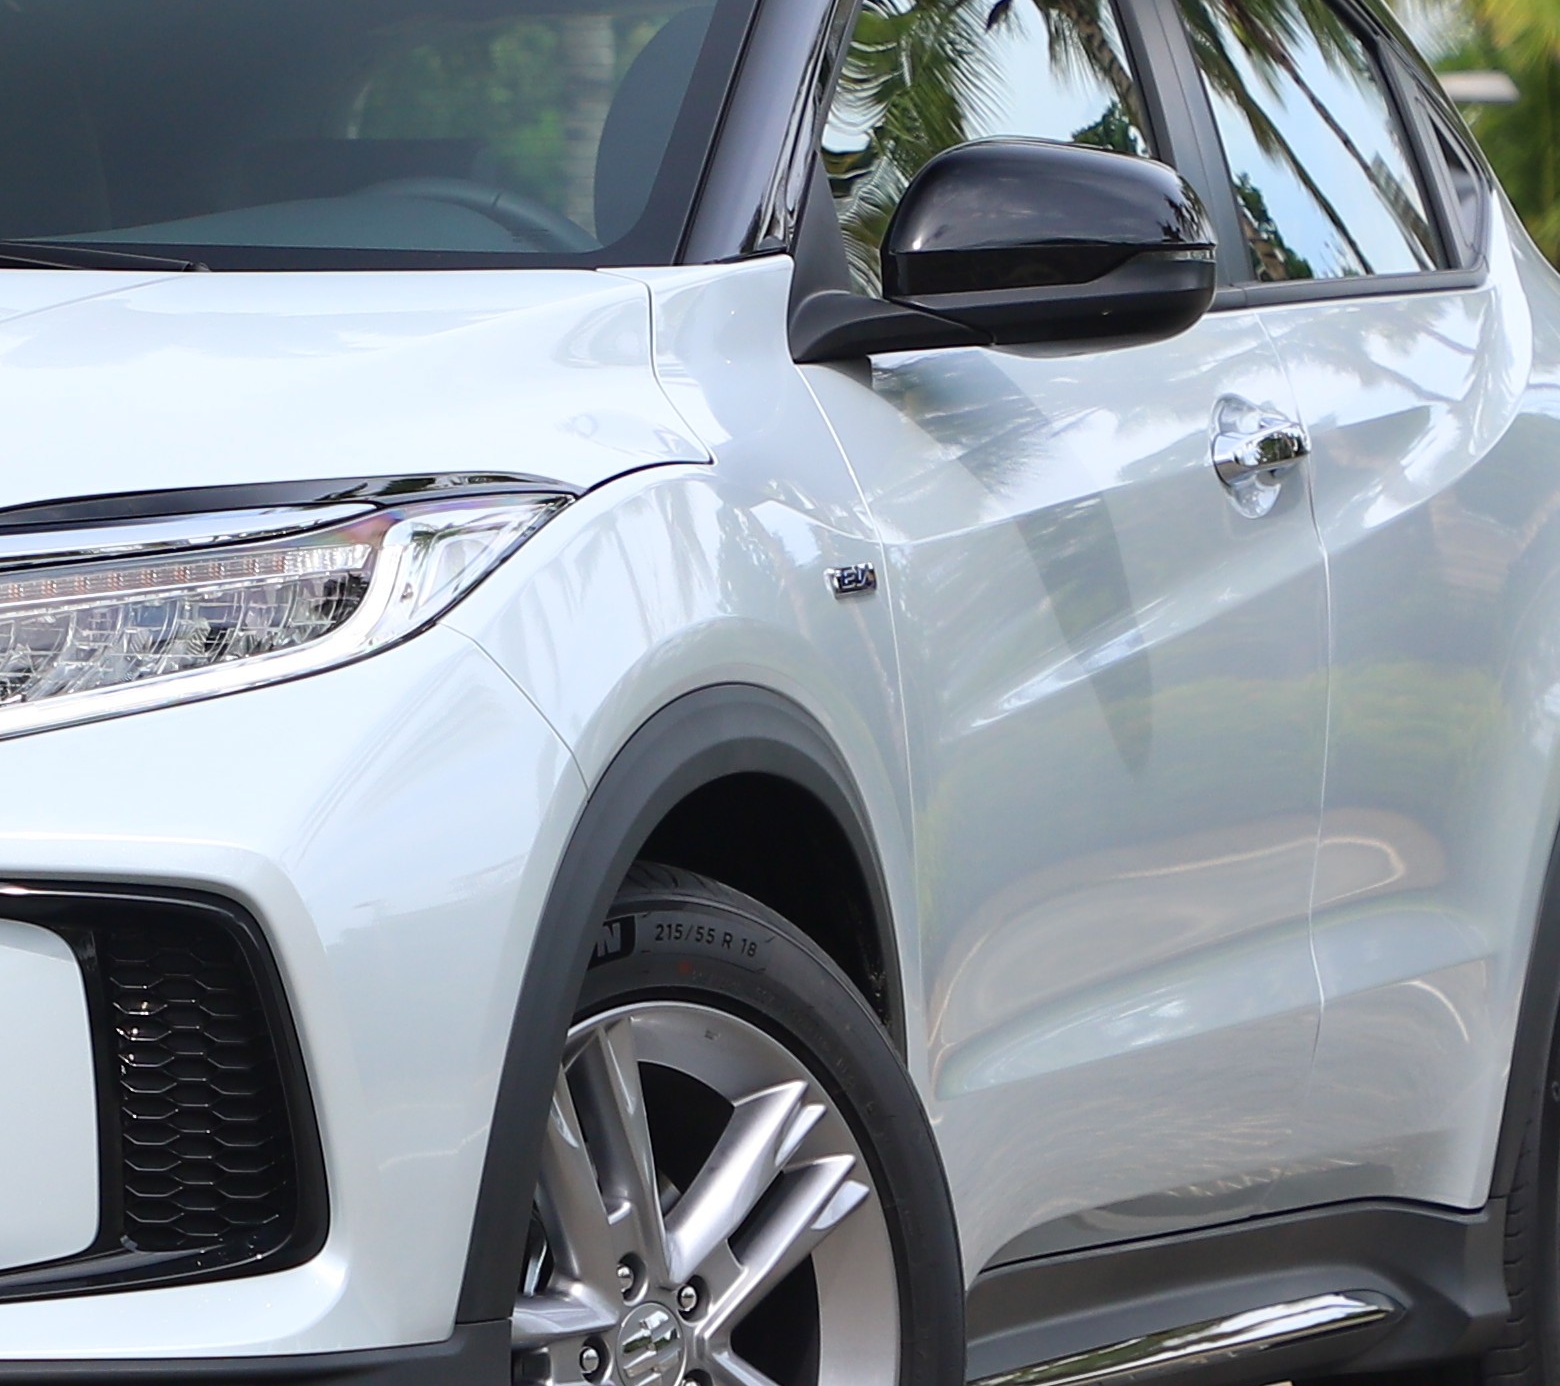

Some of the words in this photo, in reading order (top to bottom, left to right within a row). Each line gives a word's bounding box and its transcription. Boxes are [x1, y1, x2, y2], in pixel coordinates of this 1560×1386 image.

[655, 923, 716, 945] 215/55
[722, 932, 733, 950] R
[741, 938, 758, 957] 18
